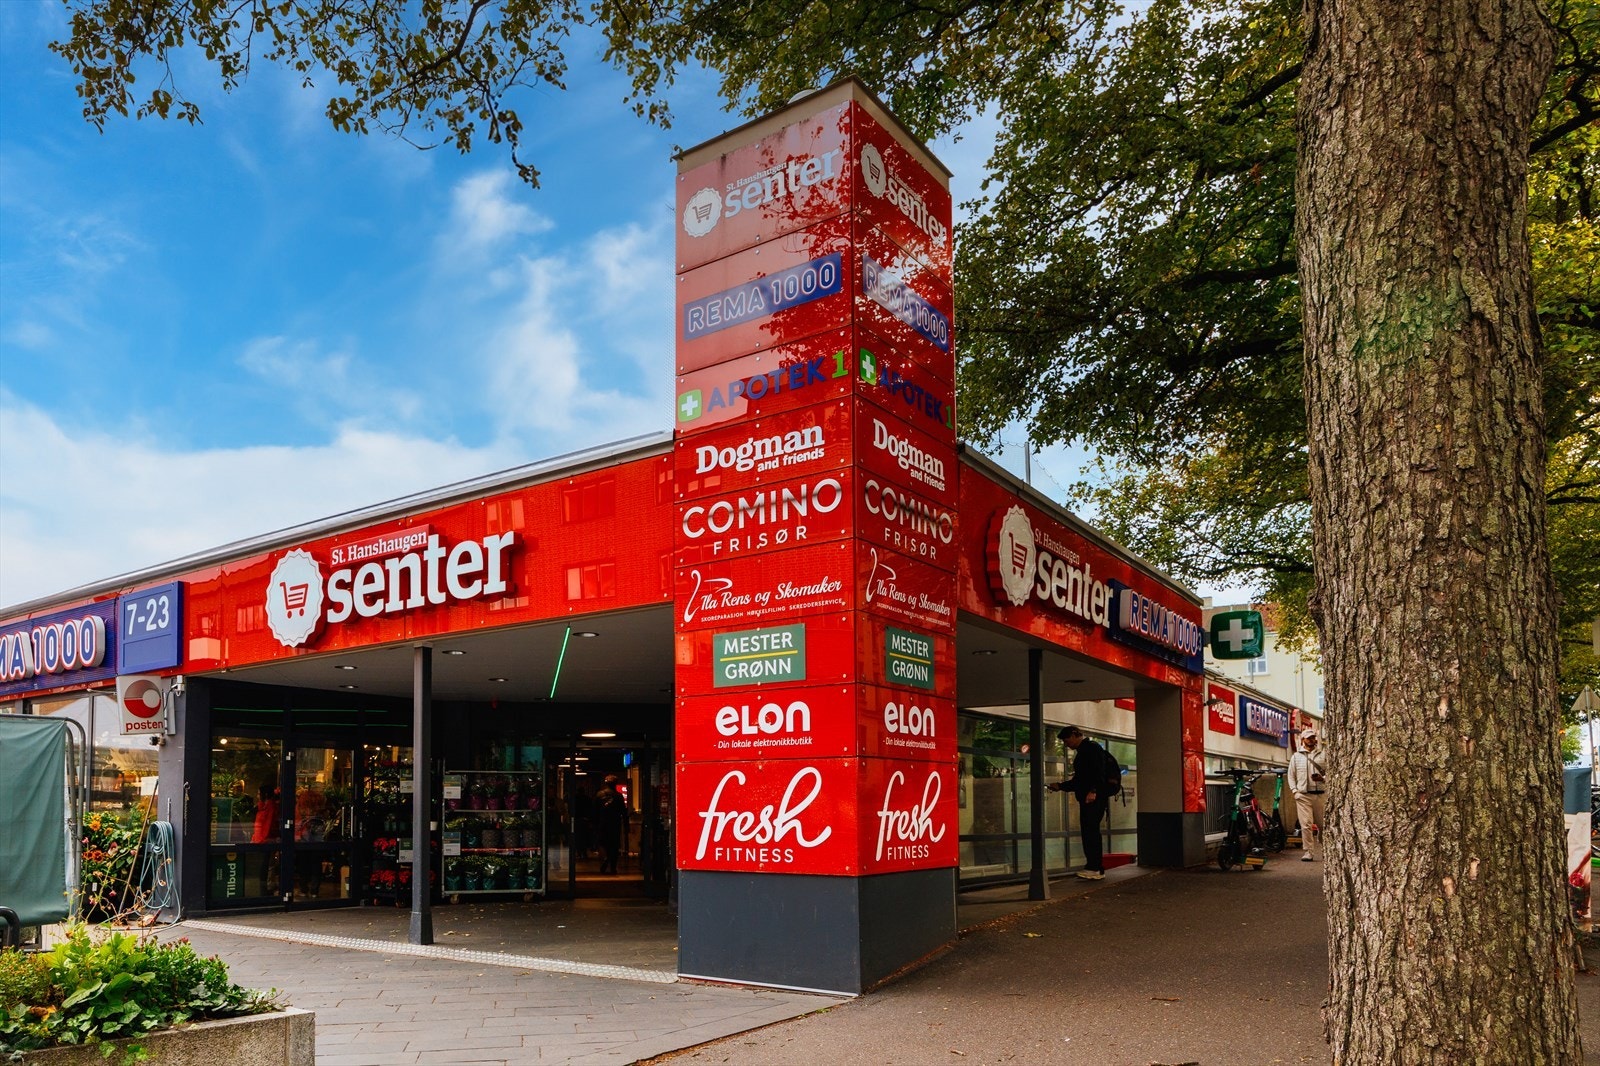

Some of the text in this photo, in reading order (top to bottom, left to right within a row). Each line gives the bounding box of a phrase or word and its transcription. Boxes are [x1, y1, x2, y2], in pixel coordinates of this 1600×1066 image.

[725, 149, 840, 218] senter
[887, 177, 948, 247] senter
[688, 262, 836, 333] REMA 1000
[865, 263, 948, 346] REMA 1000
[707, 350, 849, 412] APOTEK 1
[878, 366, 954, 430] APOTEK 1
[695, 425, 825, 474] Dogman
[757, 447, 825, 473] and friends
[873, 418, 945, 481] Dogman
[910, 468, 945, 492] and friends
[682, 478, 843, 538] COMINO
[864, 479, 953, 544] COMINO
[331, 531, 428, 566] St. Hanshaugen
[713, 525, 808, 555] FRISØR
[884, 527, 937, 560] FRISØR
[1034, 528, 1081, 566] St. Hanshaugen
[327, 531, 515, 623] senter
[721, 588, 751, 608] Rens
[755, 590, 771, 606] og
[775, 575, 843, 601] Skomaker
[1036, 551, 1113, 629] senter
[126, 595, 170, 635] 7-23
[888, 584, 906, 602] Rens
[907, 592, 917, 608] og
[918, 592, 951, 616] Skomaker
[724, 631, 793, 655] MESTER
[1130, 591, 1170, 644] REMA
[1171, 614, 1200, 657] 1000
[32, 615, 98, 676] 1000
[891, 634, 929, 658] MESTER
[725, 658, 791, 679] GRØNN
[892, 660, 929, 682] GRØNN
[125, 718, 164, 733] posten
[717, 740, 730, 749] Din
[731, 738, 752, 749] lokale
[695, 766, 832, 861] fresh
[876, 771, 945, 862] fresh
[715, 847, 794, 863] FITNESS
[887, 844, 929, 861] FITNESS
[226, 863, 237, 898] Tilbud
